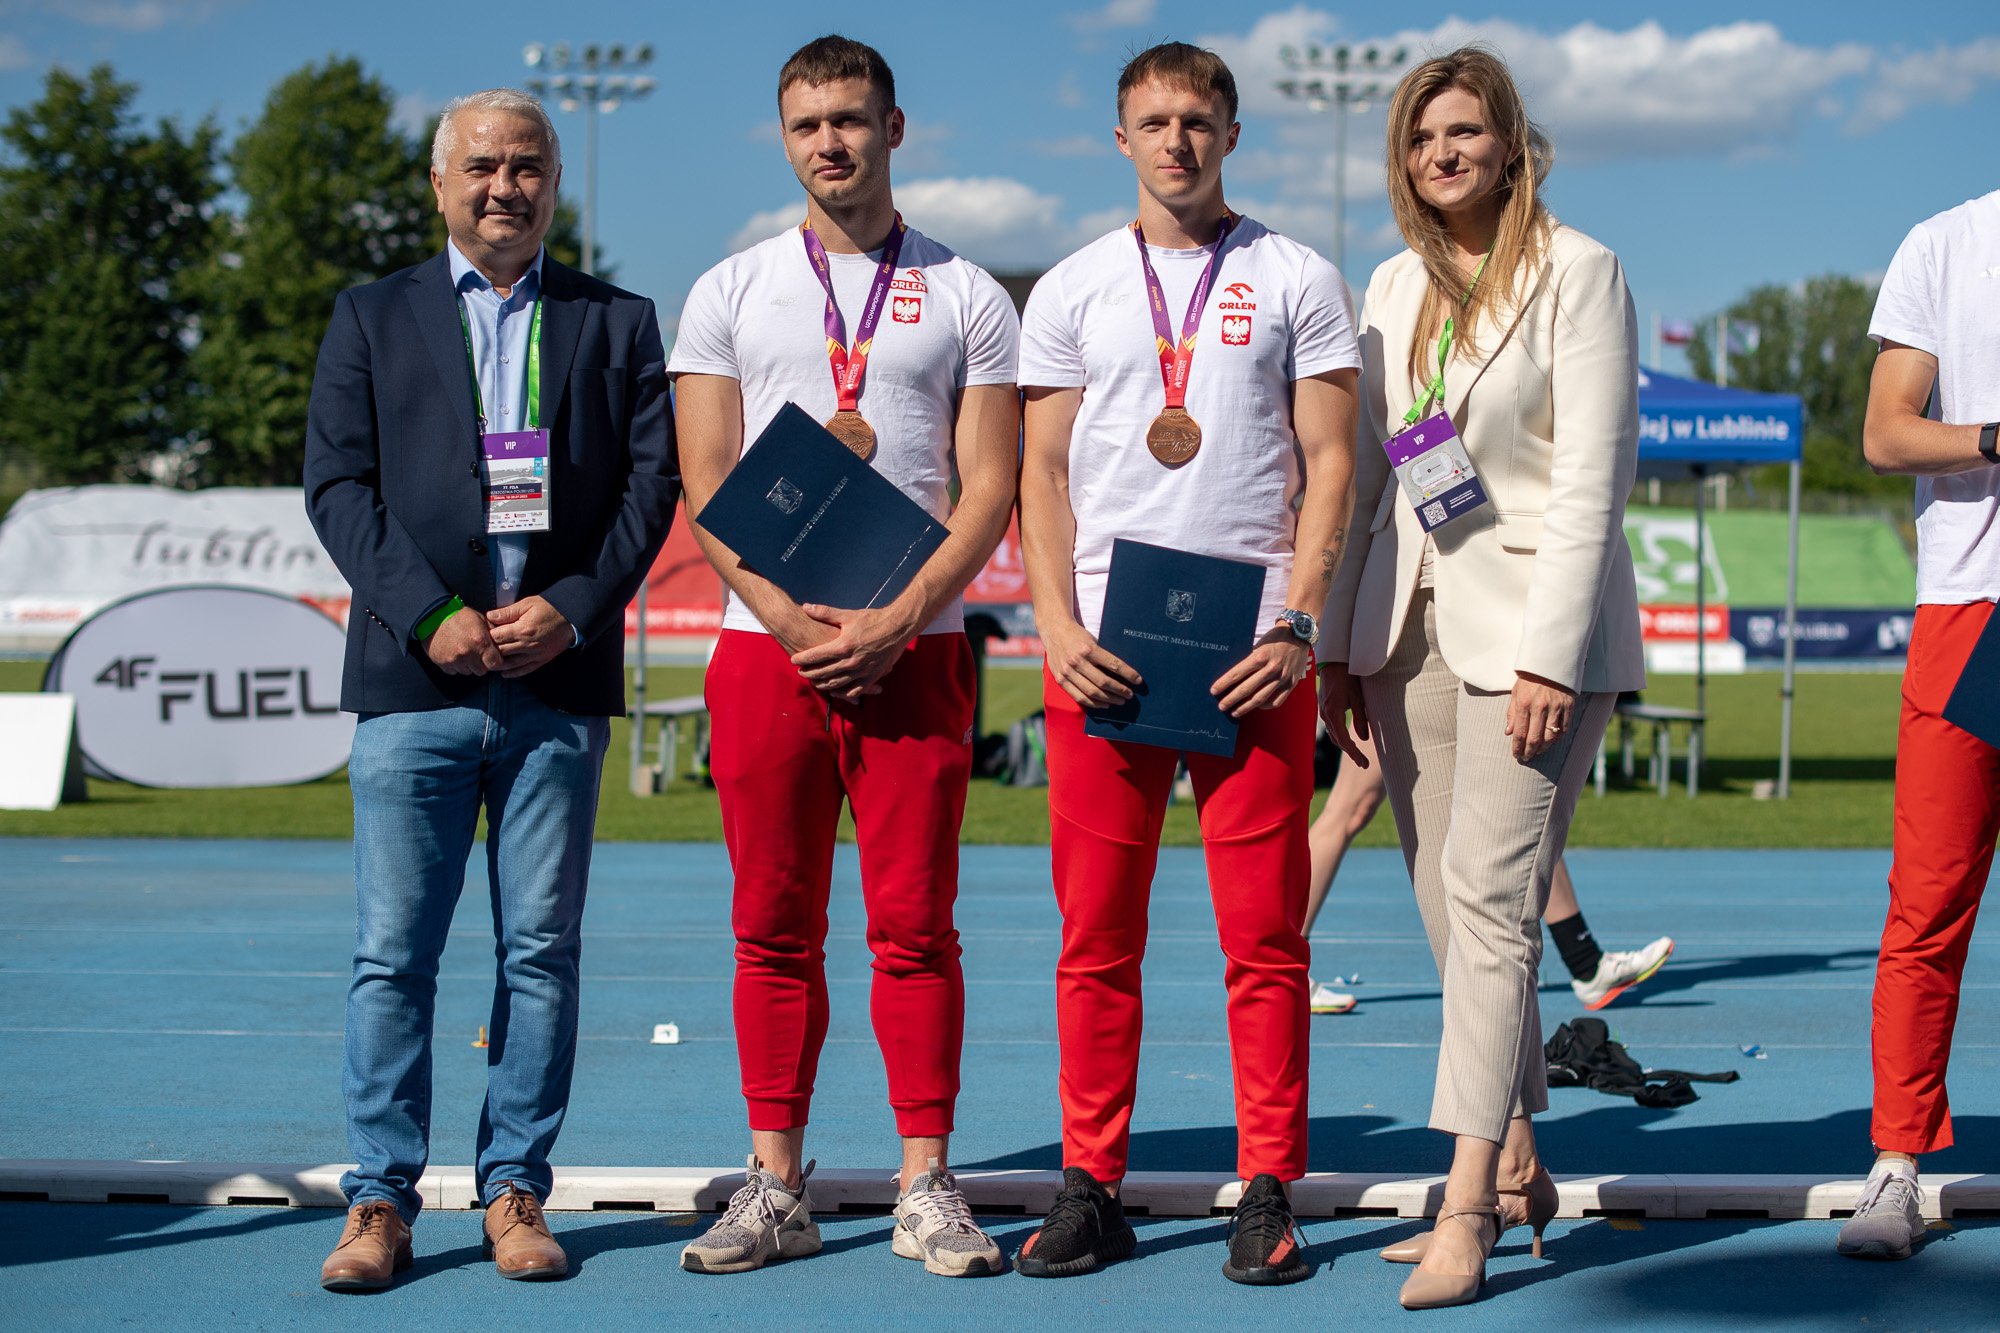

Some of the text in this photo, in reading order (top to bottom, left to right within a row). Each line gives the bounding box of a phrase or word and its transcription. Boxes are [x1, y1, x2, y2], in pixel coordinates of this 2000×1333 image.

[891, 280, 926, 291] ORLEN
[867, 282, 884, 320] CHAMPIONSHIPS
[1218, 302, 1256, 311] ORLEN
[1413, 434, 1425, 446] VIP
[1639, 413, 1789, 444] iej w Lublinie
[504, 441, 517, 450] VIP
[780, 475, 849, 562] PREZYDENT MIASTA LUBLIN
[1123, 628, 1230, 652] PREZYDENT MIASTA LUBLIN
[94, 656, 340, 723] 4F FUEL
